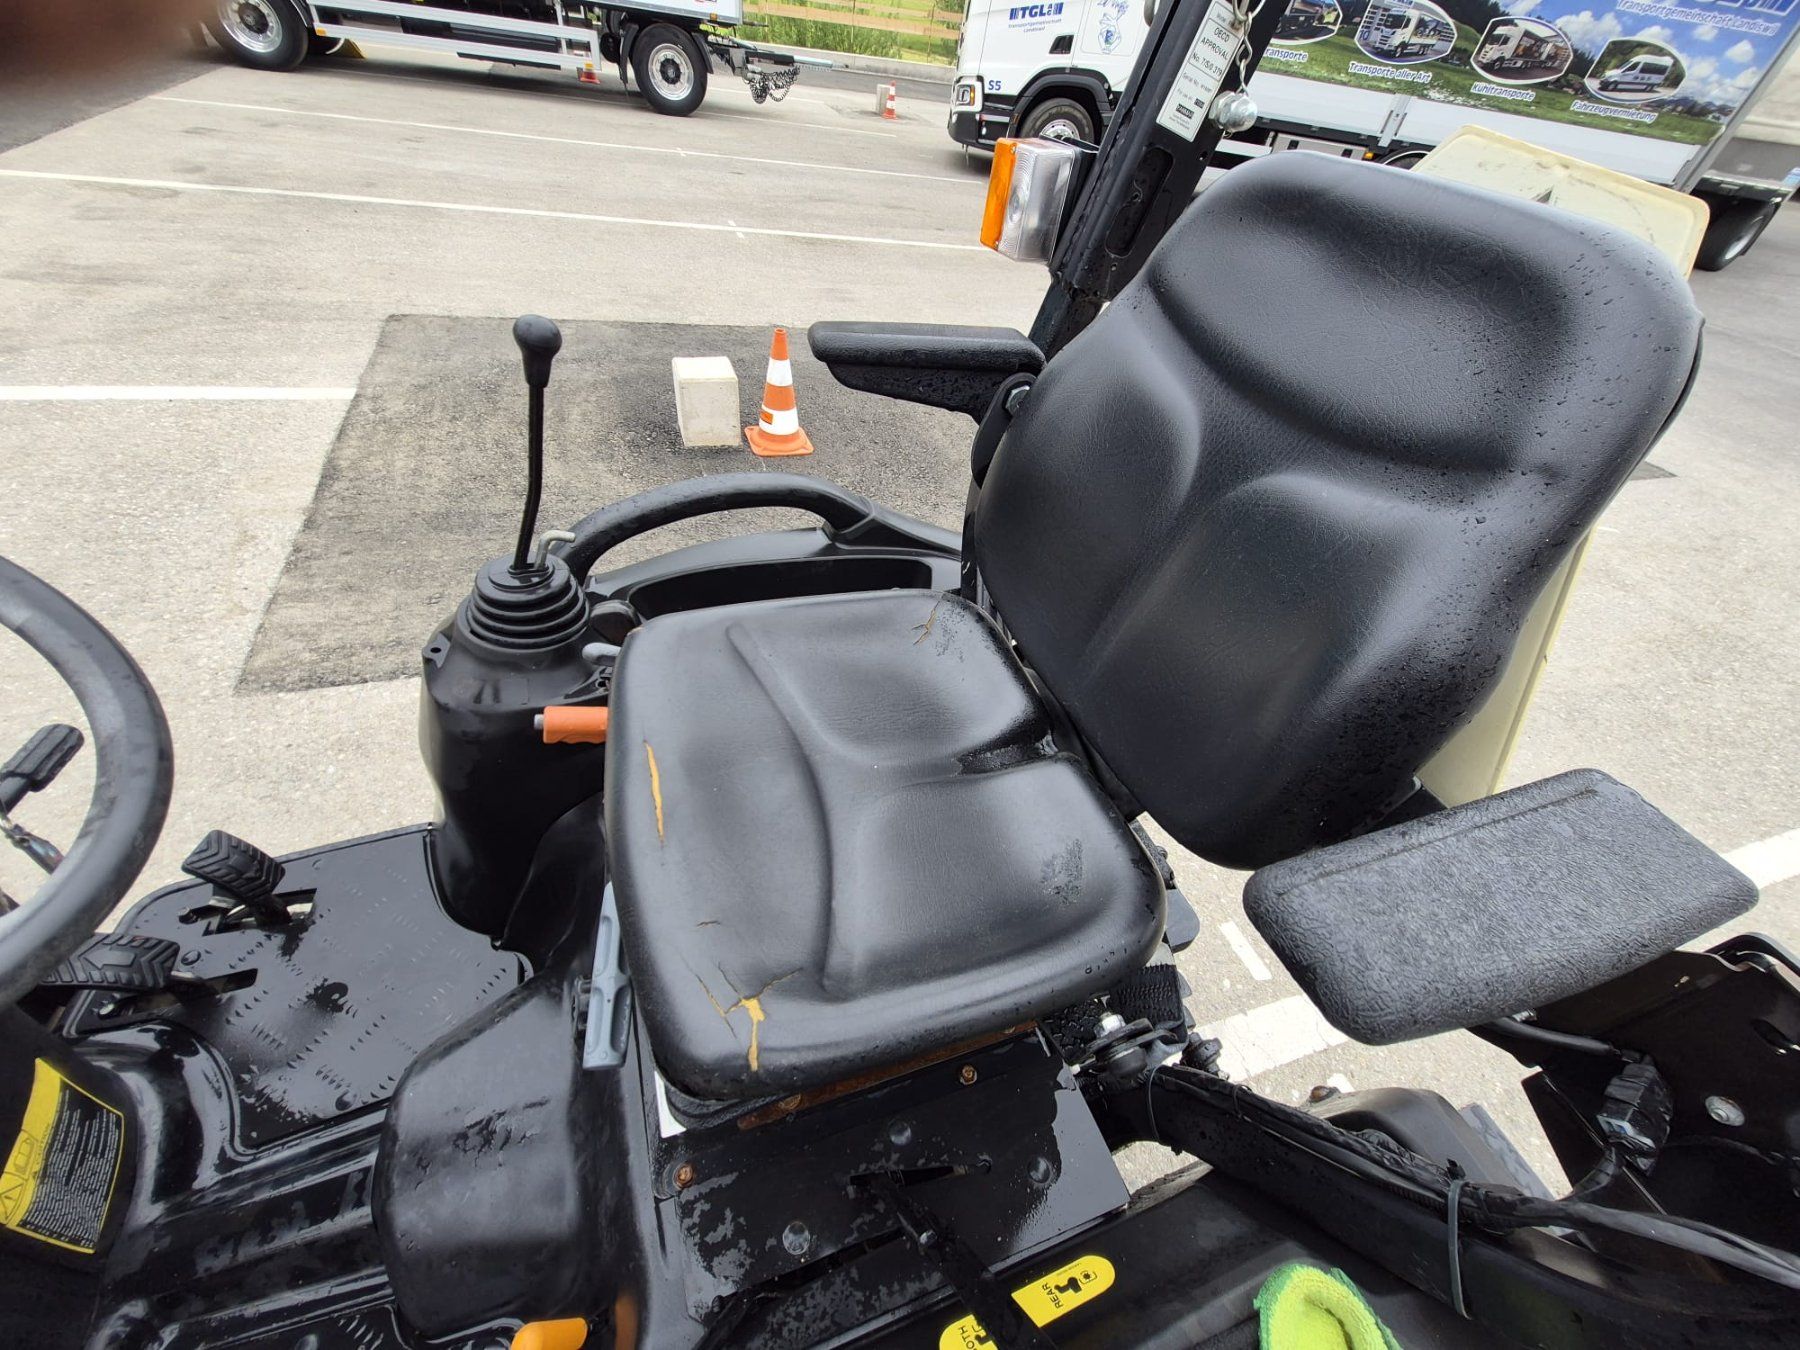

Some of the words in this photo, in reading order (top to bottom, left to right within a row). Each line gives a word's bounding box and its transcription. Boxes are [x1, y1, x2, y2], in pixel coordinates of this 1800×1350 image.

[1214, 27, 1230, 43] OECD
[1200, 37, 1229, 60] APPROVAL
[1264, 47, 1308, 61] ransporte
[1349, 62, 1395, 77] Transporte
[1395, 68, 1416, 80] aller
[1415, 71, 1431, 83] Art
[988, 79, 1002, 91] S5
[1571, 101, 1657, 122] Fahrzeugvermietung
[1041, 1282, 1063, 1308] REAR
[958, 1325, 978, 1350] OTH
